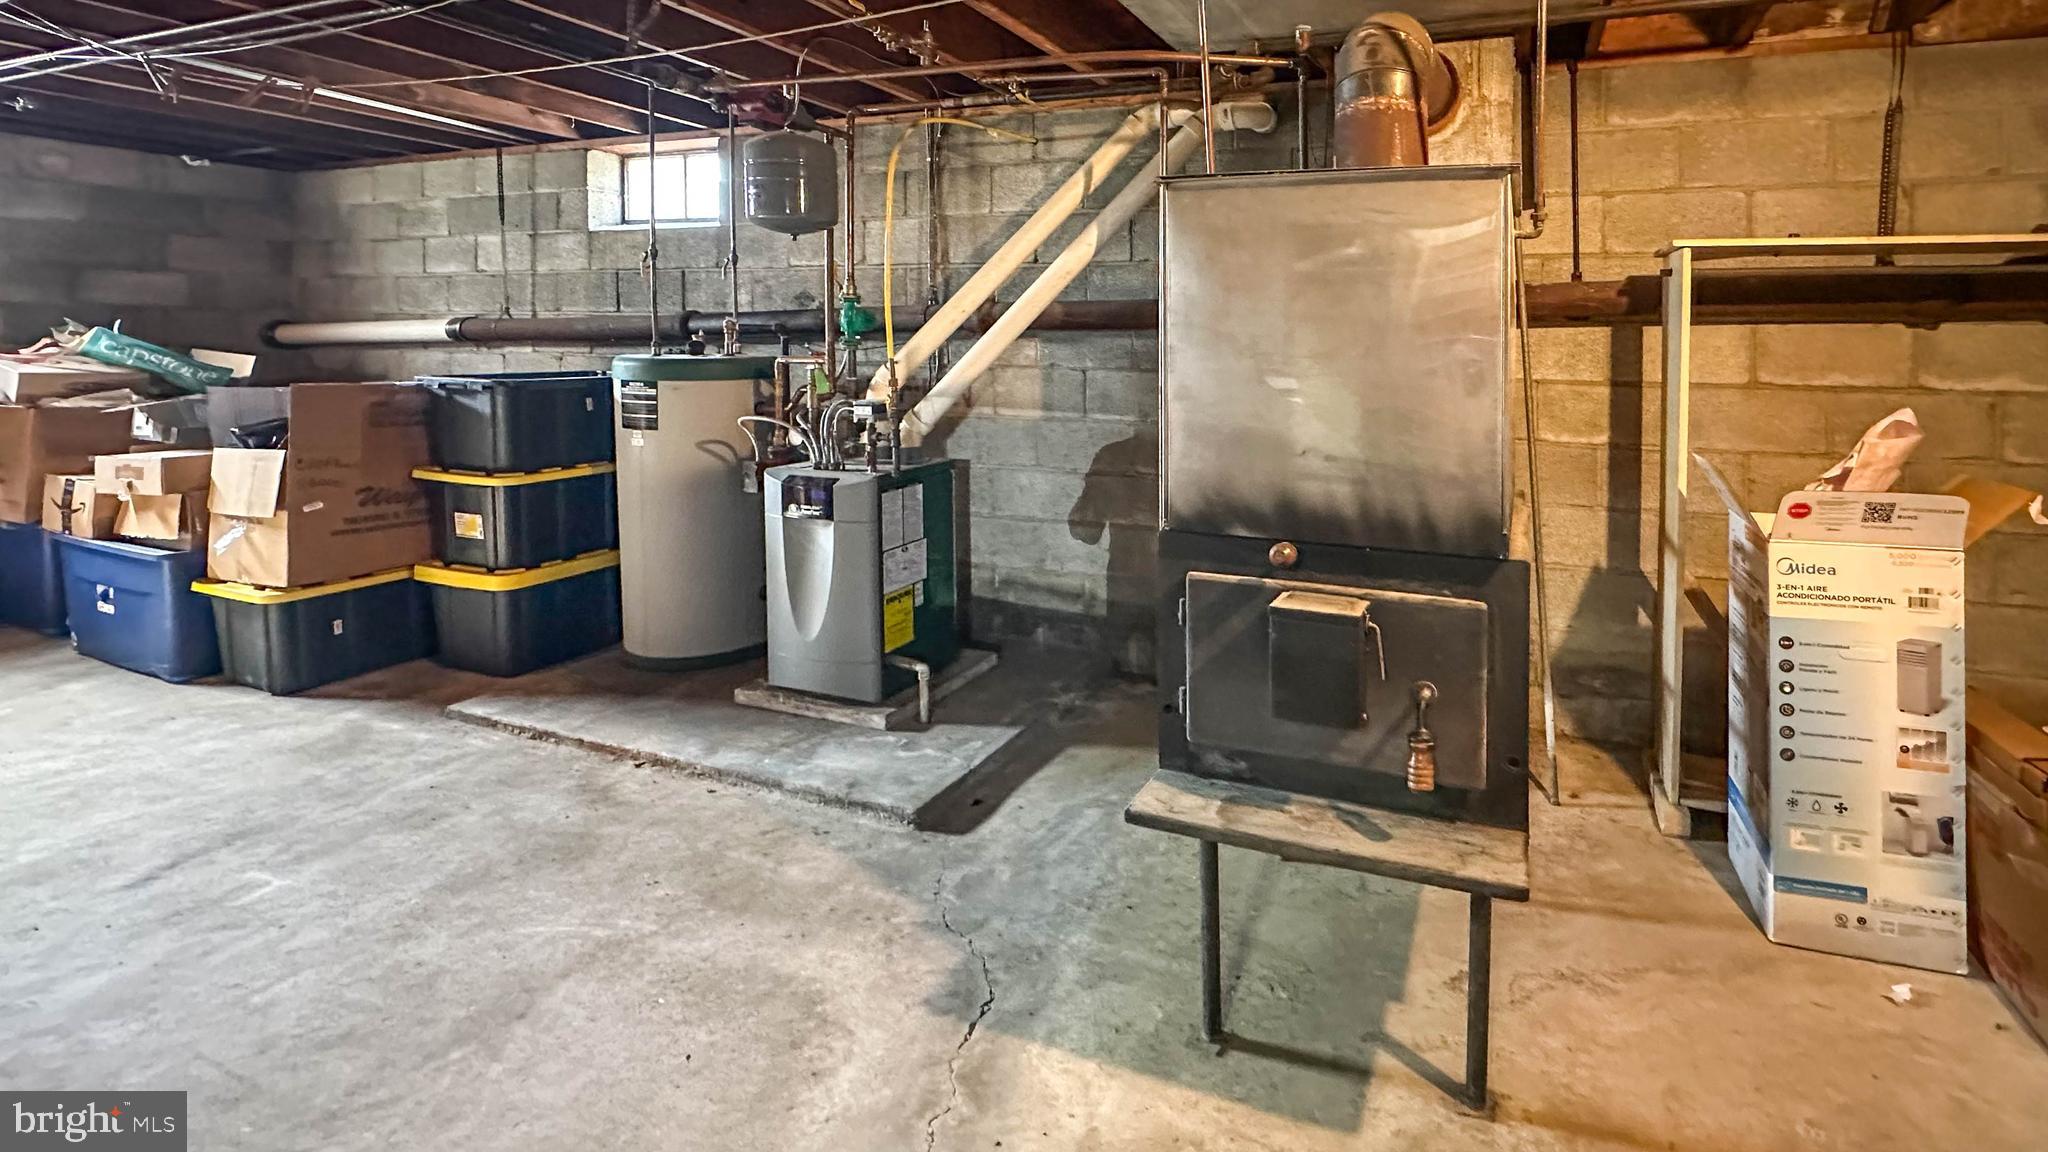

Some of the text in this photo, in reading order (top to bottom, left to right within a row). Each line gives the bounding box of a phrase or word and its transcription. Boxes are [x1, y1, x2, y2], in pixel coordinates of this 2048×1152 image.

[98, 336, 219, 383] capstone
[1776, 557, 1837, 576] Midea
[1776, 583, 1828, 593] 3-EN-1 AIRE
[1777, 592, 1896, 605] ACONDICIONADO PORTÁTIL
